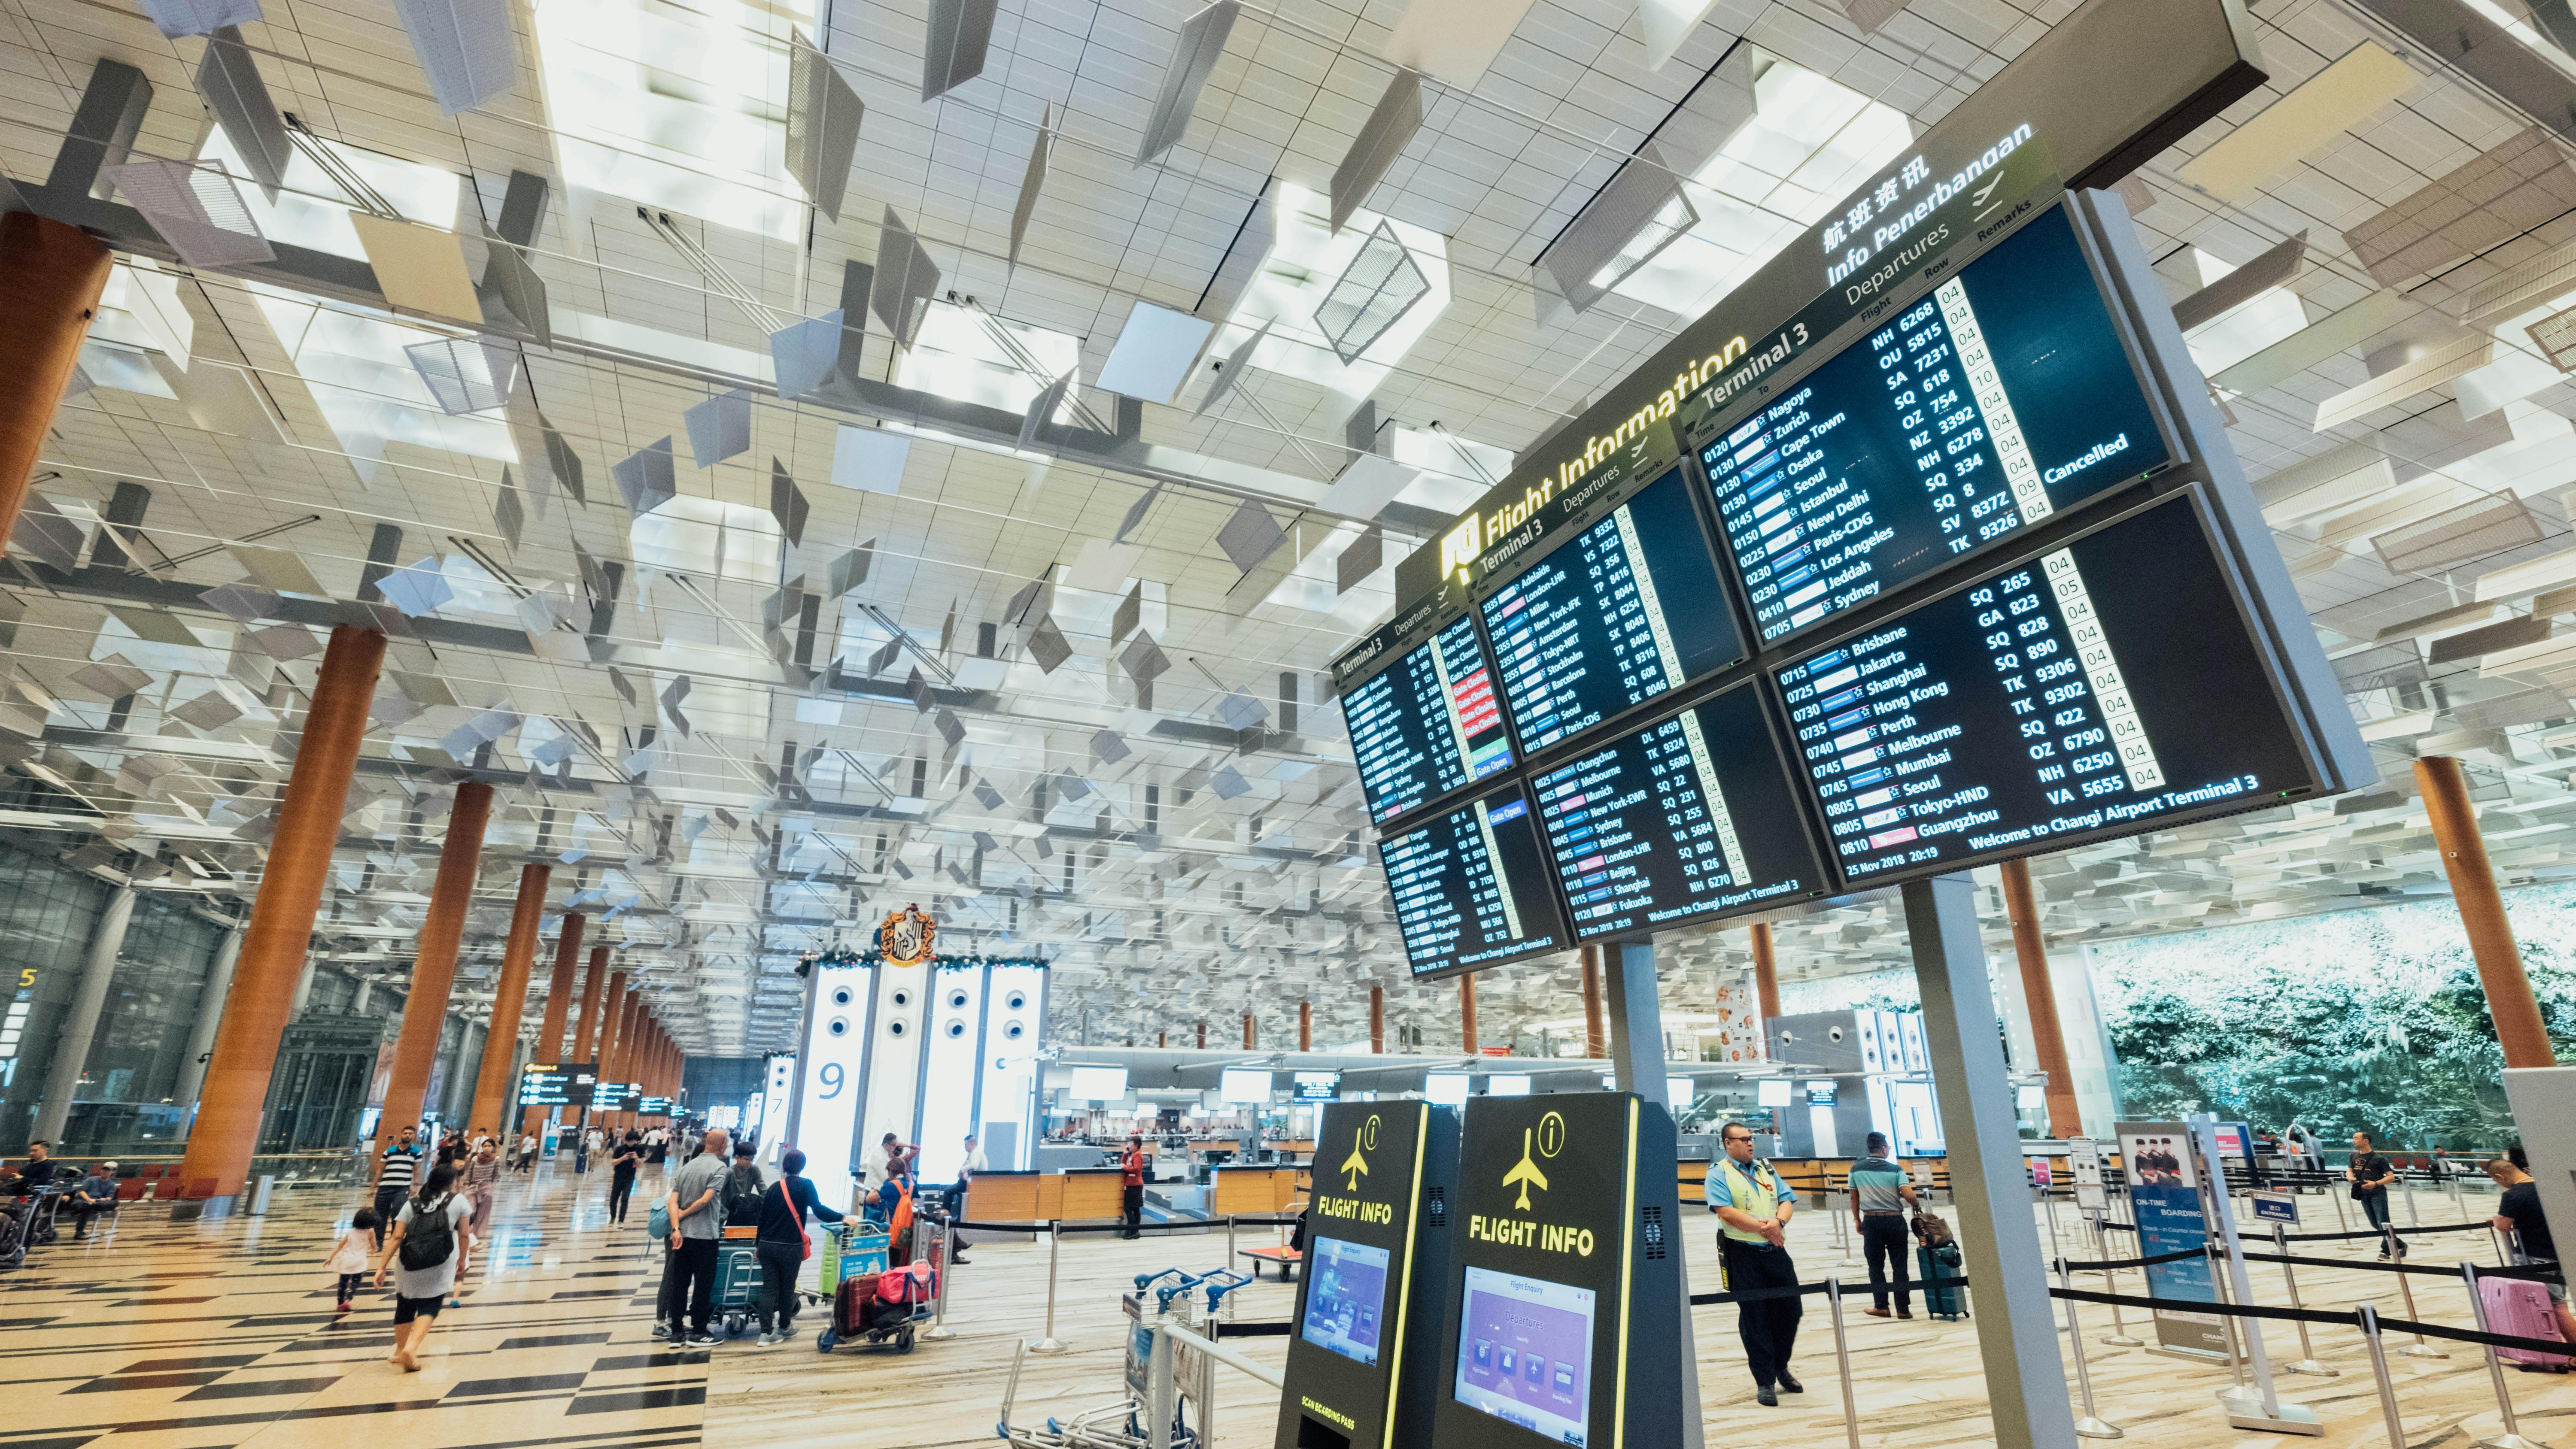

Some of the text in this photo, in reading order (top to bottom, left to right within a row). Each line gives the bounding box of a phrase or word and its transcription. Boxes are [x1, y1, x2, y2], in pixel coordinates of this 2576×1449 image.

[1823, 155, 1930, 253] 航班资讯
[1828, 124, 2032, 287] Info Penerbangan
[1695, 200, 2032, 439] Time To Flight Row Remarks
[1701, 223, 1949, 409] Terminal 3 Departures
[1704, 441, 1728, 462] 0120
[1768, 388, 1811, 421] Nagoya
[1872, 328, 1894, 350] NH
[1900, 302, 1933, 331] 6268
[1942, 286, 1959, 303] 04
[1486, 336, 1747, 546] Flight Information
[1716, 328, 1975, 497] 0130 Cape Town SA 7231 04
[1728, 511, 1752, 532] 0145
[1794, 467, 1826, 494] Seoul
[1902, 409, 1924, 429] OZ
[1930, 389, 1957, 413] 754
[1976, 370, 1992, 385] 10
[1480, 465, 1619, 573] Terminal 3 Departures
[1572, 510, 1589, 527] Flight
[1607, 491, 1620, 503] Row
[1634, 459, 1663, 482] Remarks
[1740, 546, 1765, 567] 0225
[1807, 510, 1834, 532] New
[1835, 489, 1869, 516] Delhi
[1917, 450, 1941, 471] NH
[1947, 427, 1983, 454] 6278
[1992, 413, 2010, 430] 04
[1758, 601, 1783, 621] 0410
[1829, 561, 1871, 589] Jeddah
[1941, 513, 1959, 533] SV
[2018, 479, 2035, 496] 09
[2044, 433, 2128, 483] Cancelled
[1340, 605, 1431, 675] Terminal 3 Departures
[1439, 617, 1470, 643] Gate Closed
[1495, 558, 1643, 655] 2355 New York-JFK TP 8416 04
[1780, 557, 2069, 685] 0715 Brisbane SQ 265 04
[1800, 626, 2097, 740] 0735 Hong Kong SQ 890 04
[1535, 775, 1551, 788] 0025
[1576, 750, 1616, 771] Changchun
[1641, 732, 1654, 744] DL
[1658, 721, 1679, 737] 6459
[1684, 715, 1694, 725] 10
[1490, 806, 1521, 823] Gate Open
[1840, 839, 1868, 855] 0810
[1918, 809, 1999, 837] Guangzhou
[2046, 788, 2075, 804] VA
[2081, 775, 2123, 797] 5655
[2135, 769, 2156, 784] 04
[1968, 775, 2258, 849] Welcome to Changi Airport Terminal 3
[1846, 847, 1938, 875] 25 Nov 2018 20:19
[18, 969, 37, 986] 5
[773, 1098, 782, 1113] 7
[819, 1063, 845, 1099] 9
[1318, 1196, 1392, 1225] FLIGHT INFO
[1470, 1215, 1594, 1257] FLIGHT INFO
[2160, 1209, 2202, 1218] BOARDING
[2260, 1210, 2291, 1218] ENTRANCE
[1349, 1247, 1361, 1256] Enquiry
[1510, 1280, 1543, 1295] Flight Enquiry
[1505, 1311, 1544, 1331] Departures
[1302, 1396, 1355, 1430] SCAN BOARDING PASS
